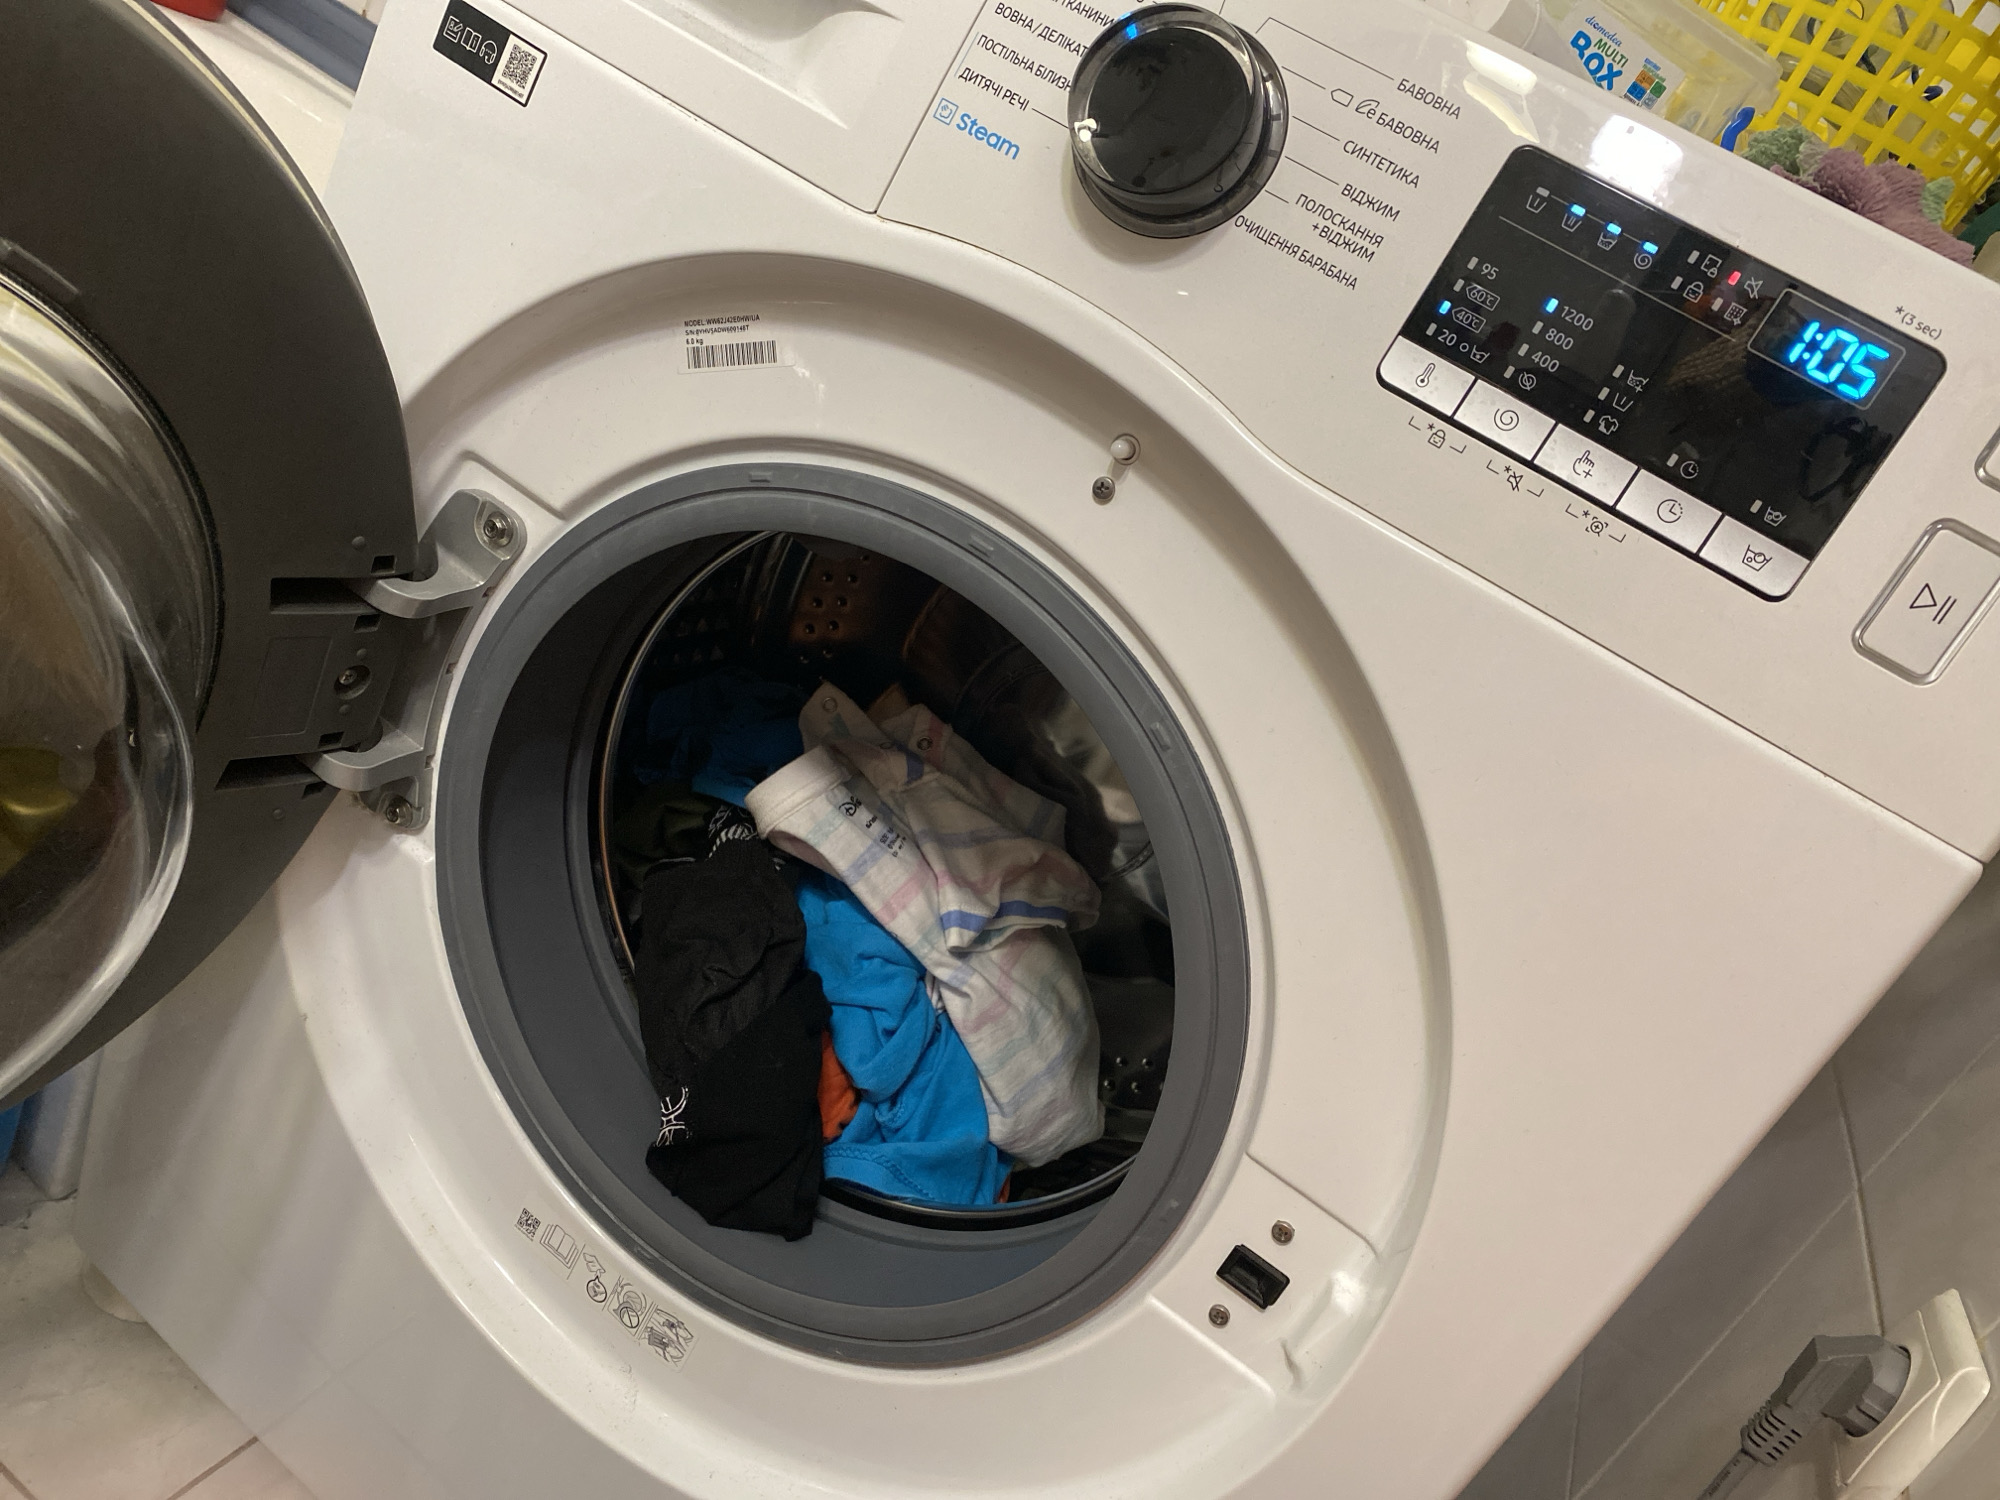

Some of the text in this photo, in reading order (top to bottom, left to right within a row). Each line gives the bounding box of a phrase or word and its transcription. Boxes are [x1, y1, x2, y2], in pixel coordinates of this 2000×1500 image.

[994, 2, 1034, 31] ВОВНА
[1585, 16, 1622, 47] diomedea
[976, 34, 1034, 73] ПОСТІЛЬНА
[1593, 38, 1629, 68] MULTI
[958, 67, 1030, 111] ДИТЯЧІ РЕЧІ
[1396, 78, 1461, 120] БАВОВНА
[956, 112, 1020, 160] Steam
[1376, 112, 1440, 154] БАВОВНА
[1343, 140, 1420, 188] СИНТЕТИКА
[1295, 193, 1384, 248] ПОЛОСКАННЯ
[1341, 183, 1401, 222] ВІДЖИМ
[1234, 215, 1358, 291] ОЧИЩЕННЯ БАРАБАНА
[1480, 263, 1499, 280] 95
[1437, 329, 1457, 346] 20
[1561, 306, 1594, 331] 1200
[1545, 328, 1574, 350] 800
[1531, 351, 1560, 373] 400
[1788, 321, 1890, 400] 1:05
